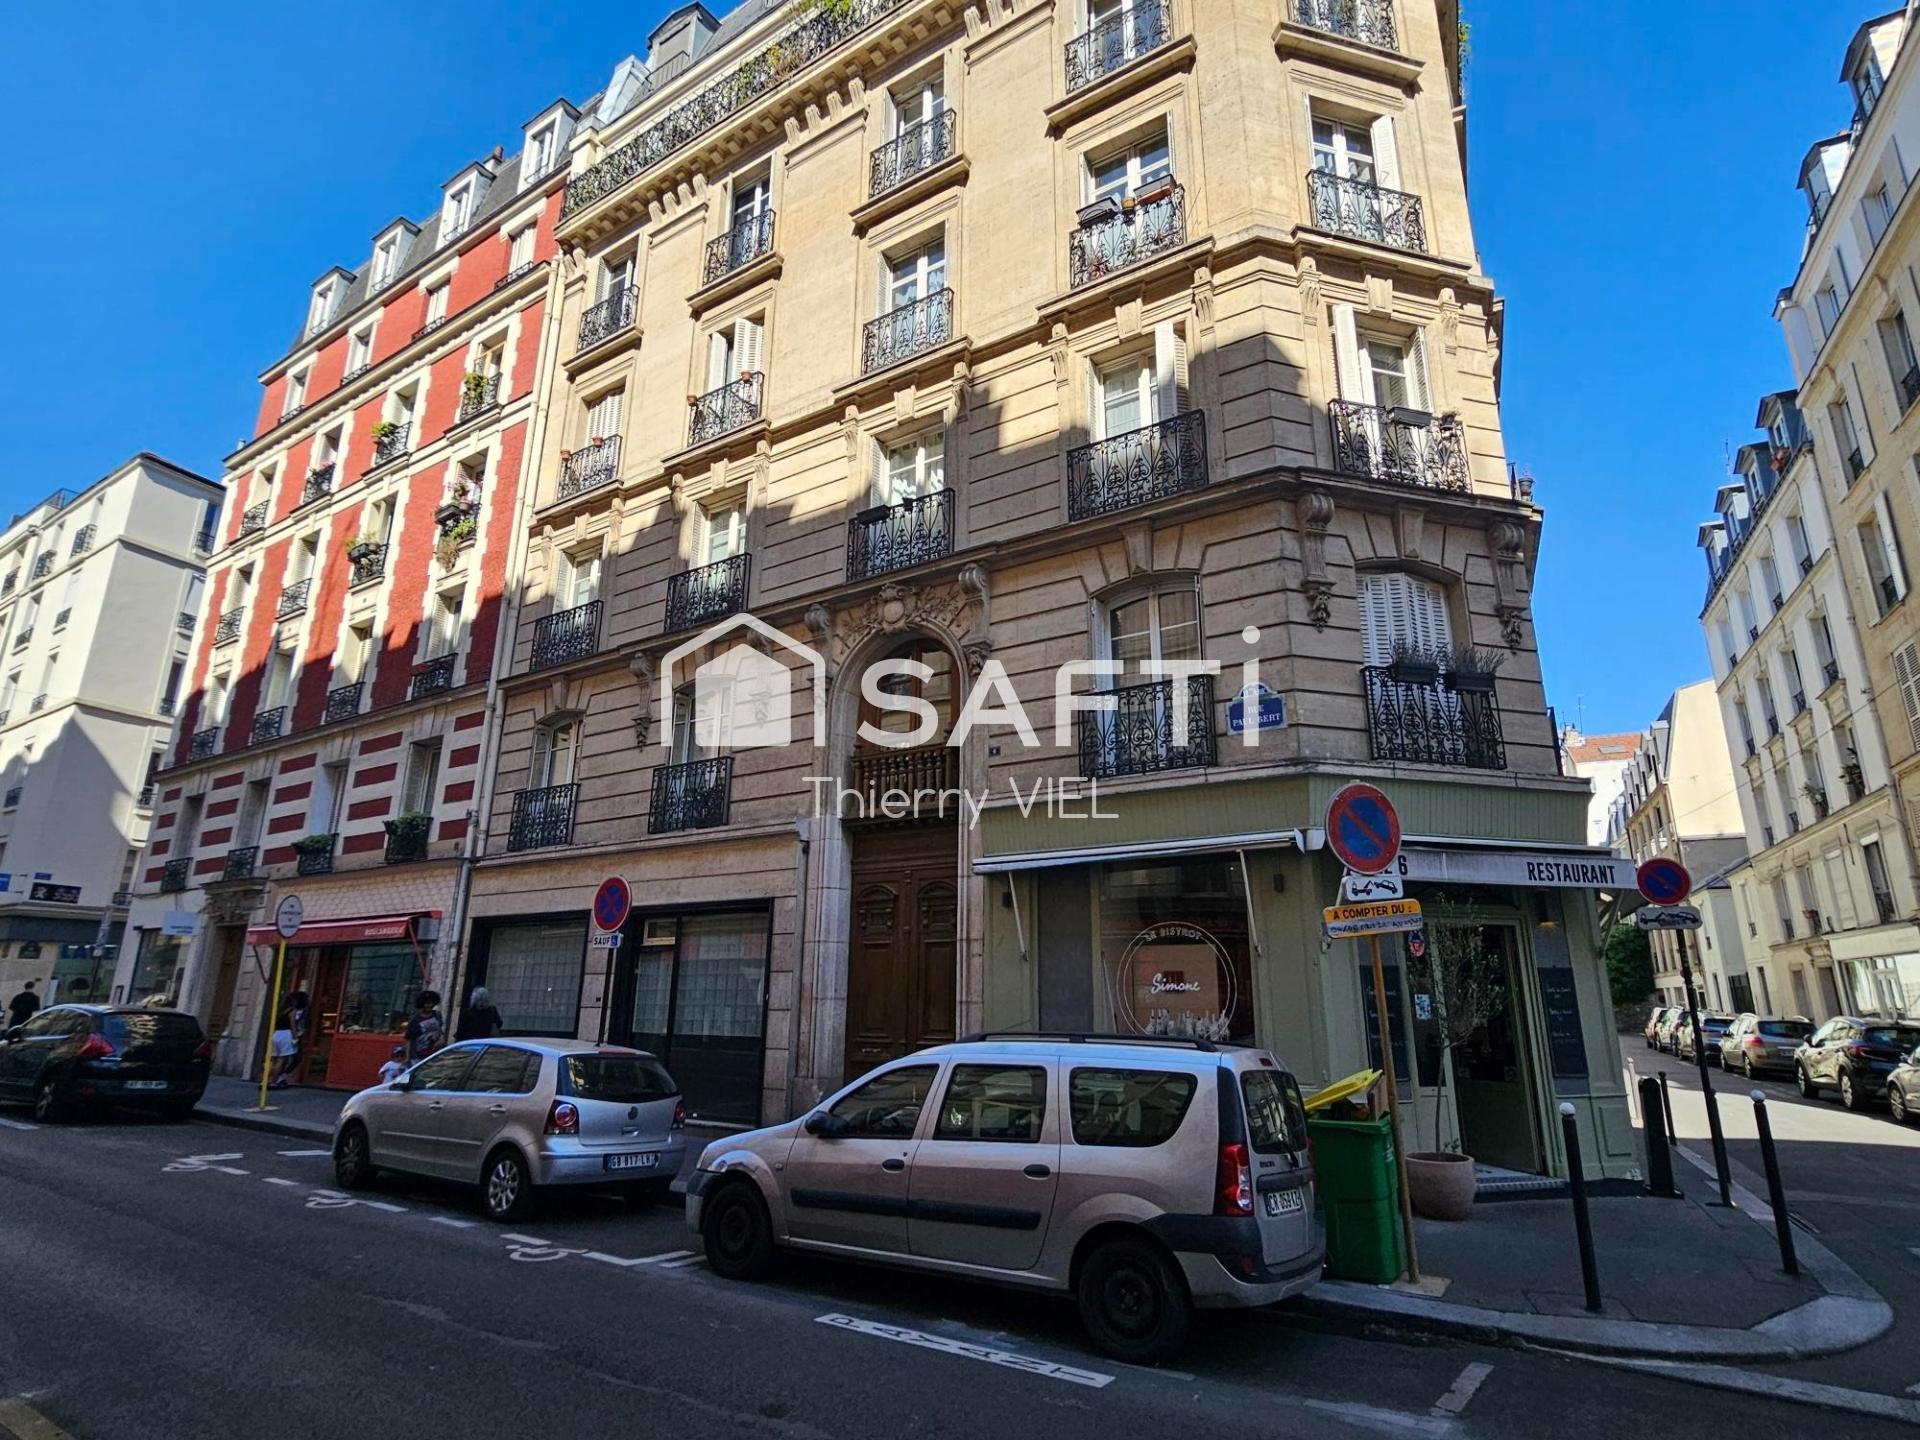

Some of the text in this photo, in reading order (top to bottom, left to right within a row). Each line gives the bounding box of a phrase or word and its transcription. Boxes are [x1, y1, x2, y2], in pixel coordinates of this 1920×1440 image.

[1247, 705, 1264, 714] RUE
[1233, 713, 1281, 727] PAUL BERT
[1398, 855, 1408, 876] 6
[1526, 861, 1616, 884] RESTAURANT
[1333, 910, 1340, 920] A
[1342, 906, 1389, 919] COMPTER
[1391, 904, 1405, 915] DU
[593, 936, 611, 946] SAUF
[1151, 973, 1201, 994] Simone
[828, 1316, 1097, 1382] PAYANT
